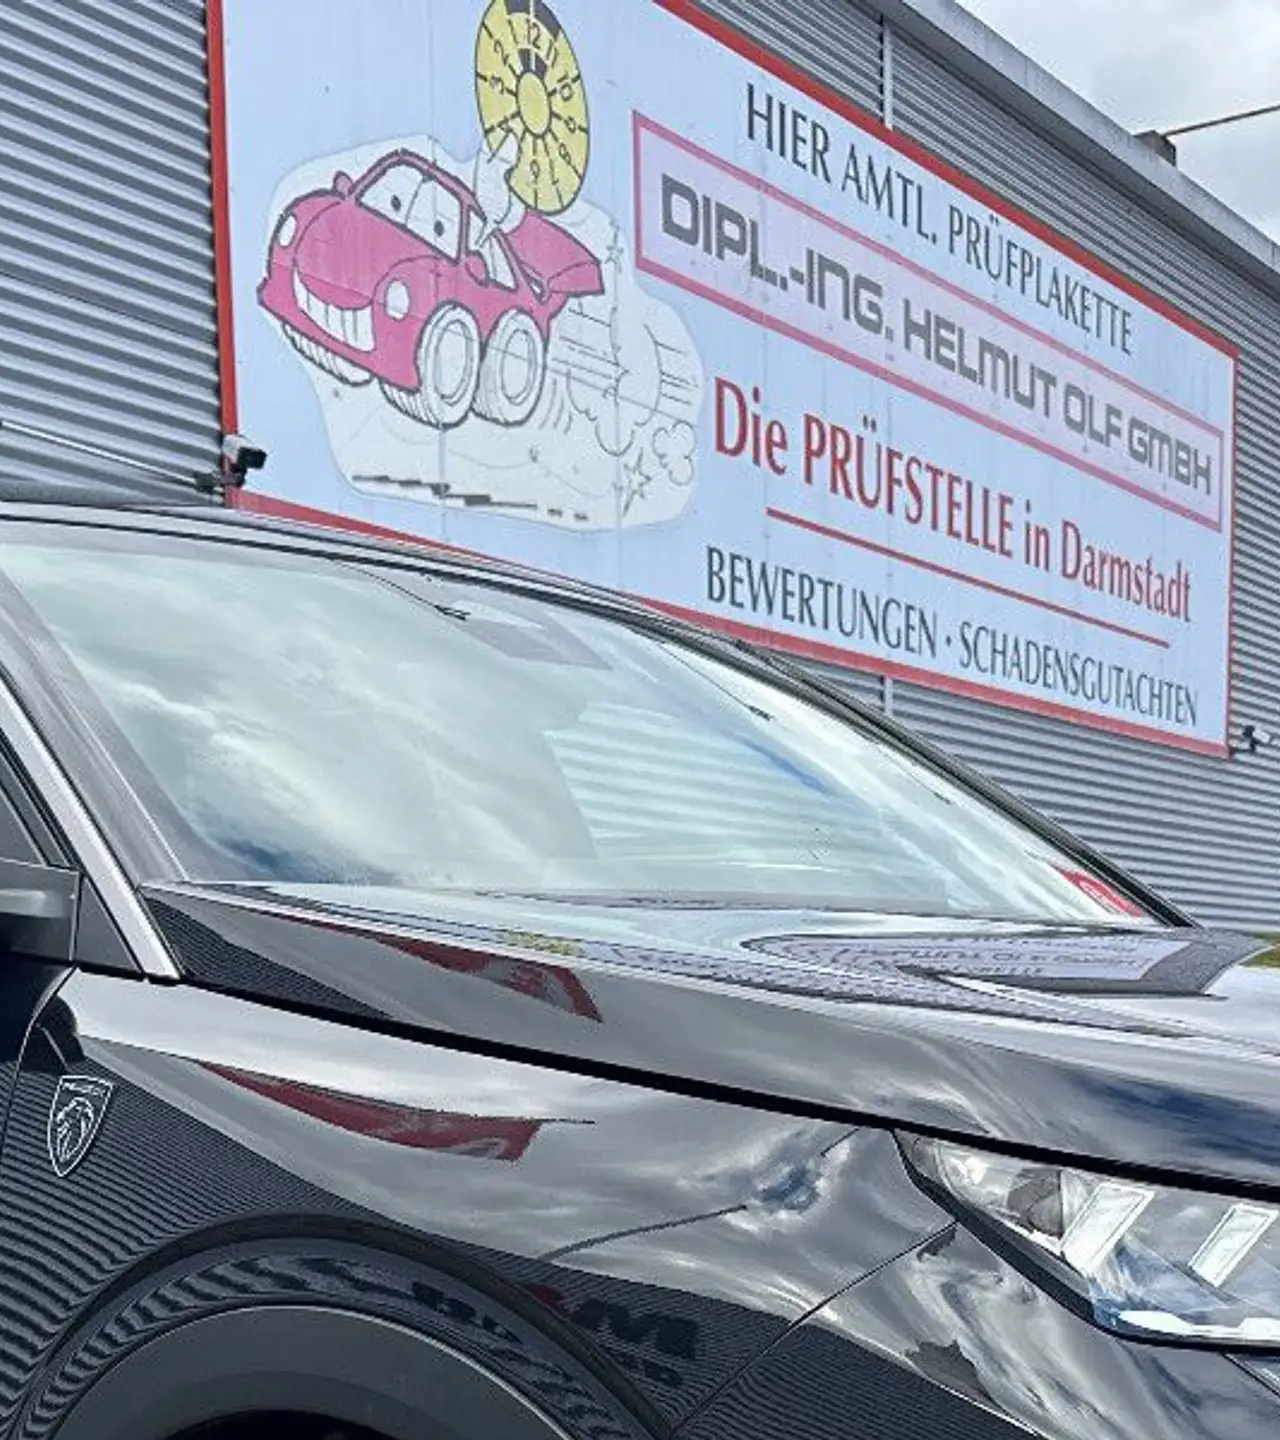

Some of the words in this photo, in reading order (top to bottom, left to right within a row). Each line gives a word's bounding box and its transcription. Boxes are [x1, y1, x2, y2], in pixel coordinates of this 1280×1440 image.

[747, 82, 832, 184] HIER
[841, 143, 937, 245] AMTL.
[948, 203, 1133, 356] PRÜFPLAKETTE
[903, 297, 1057, 419] HELMUT
[1063, 381, 1123, 448] OLF
[715, 376, 789, 476] Die
[803, 413, 1014, 559] PRÜFSTELLE
[1025, 499, 1050, 573] in
[1061, 519, 1191, 623] Darmstadt
[707, 546, 938, 658] BEWERTUNGEN
[959, 621, 1198, 726] SCHADENSGUTACHTEN
